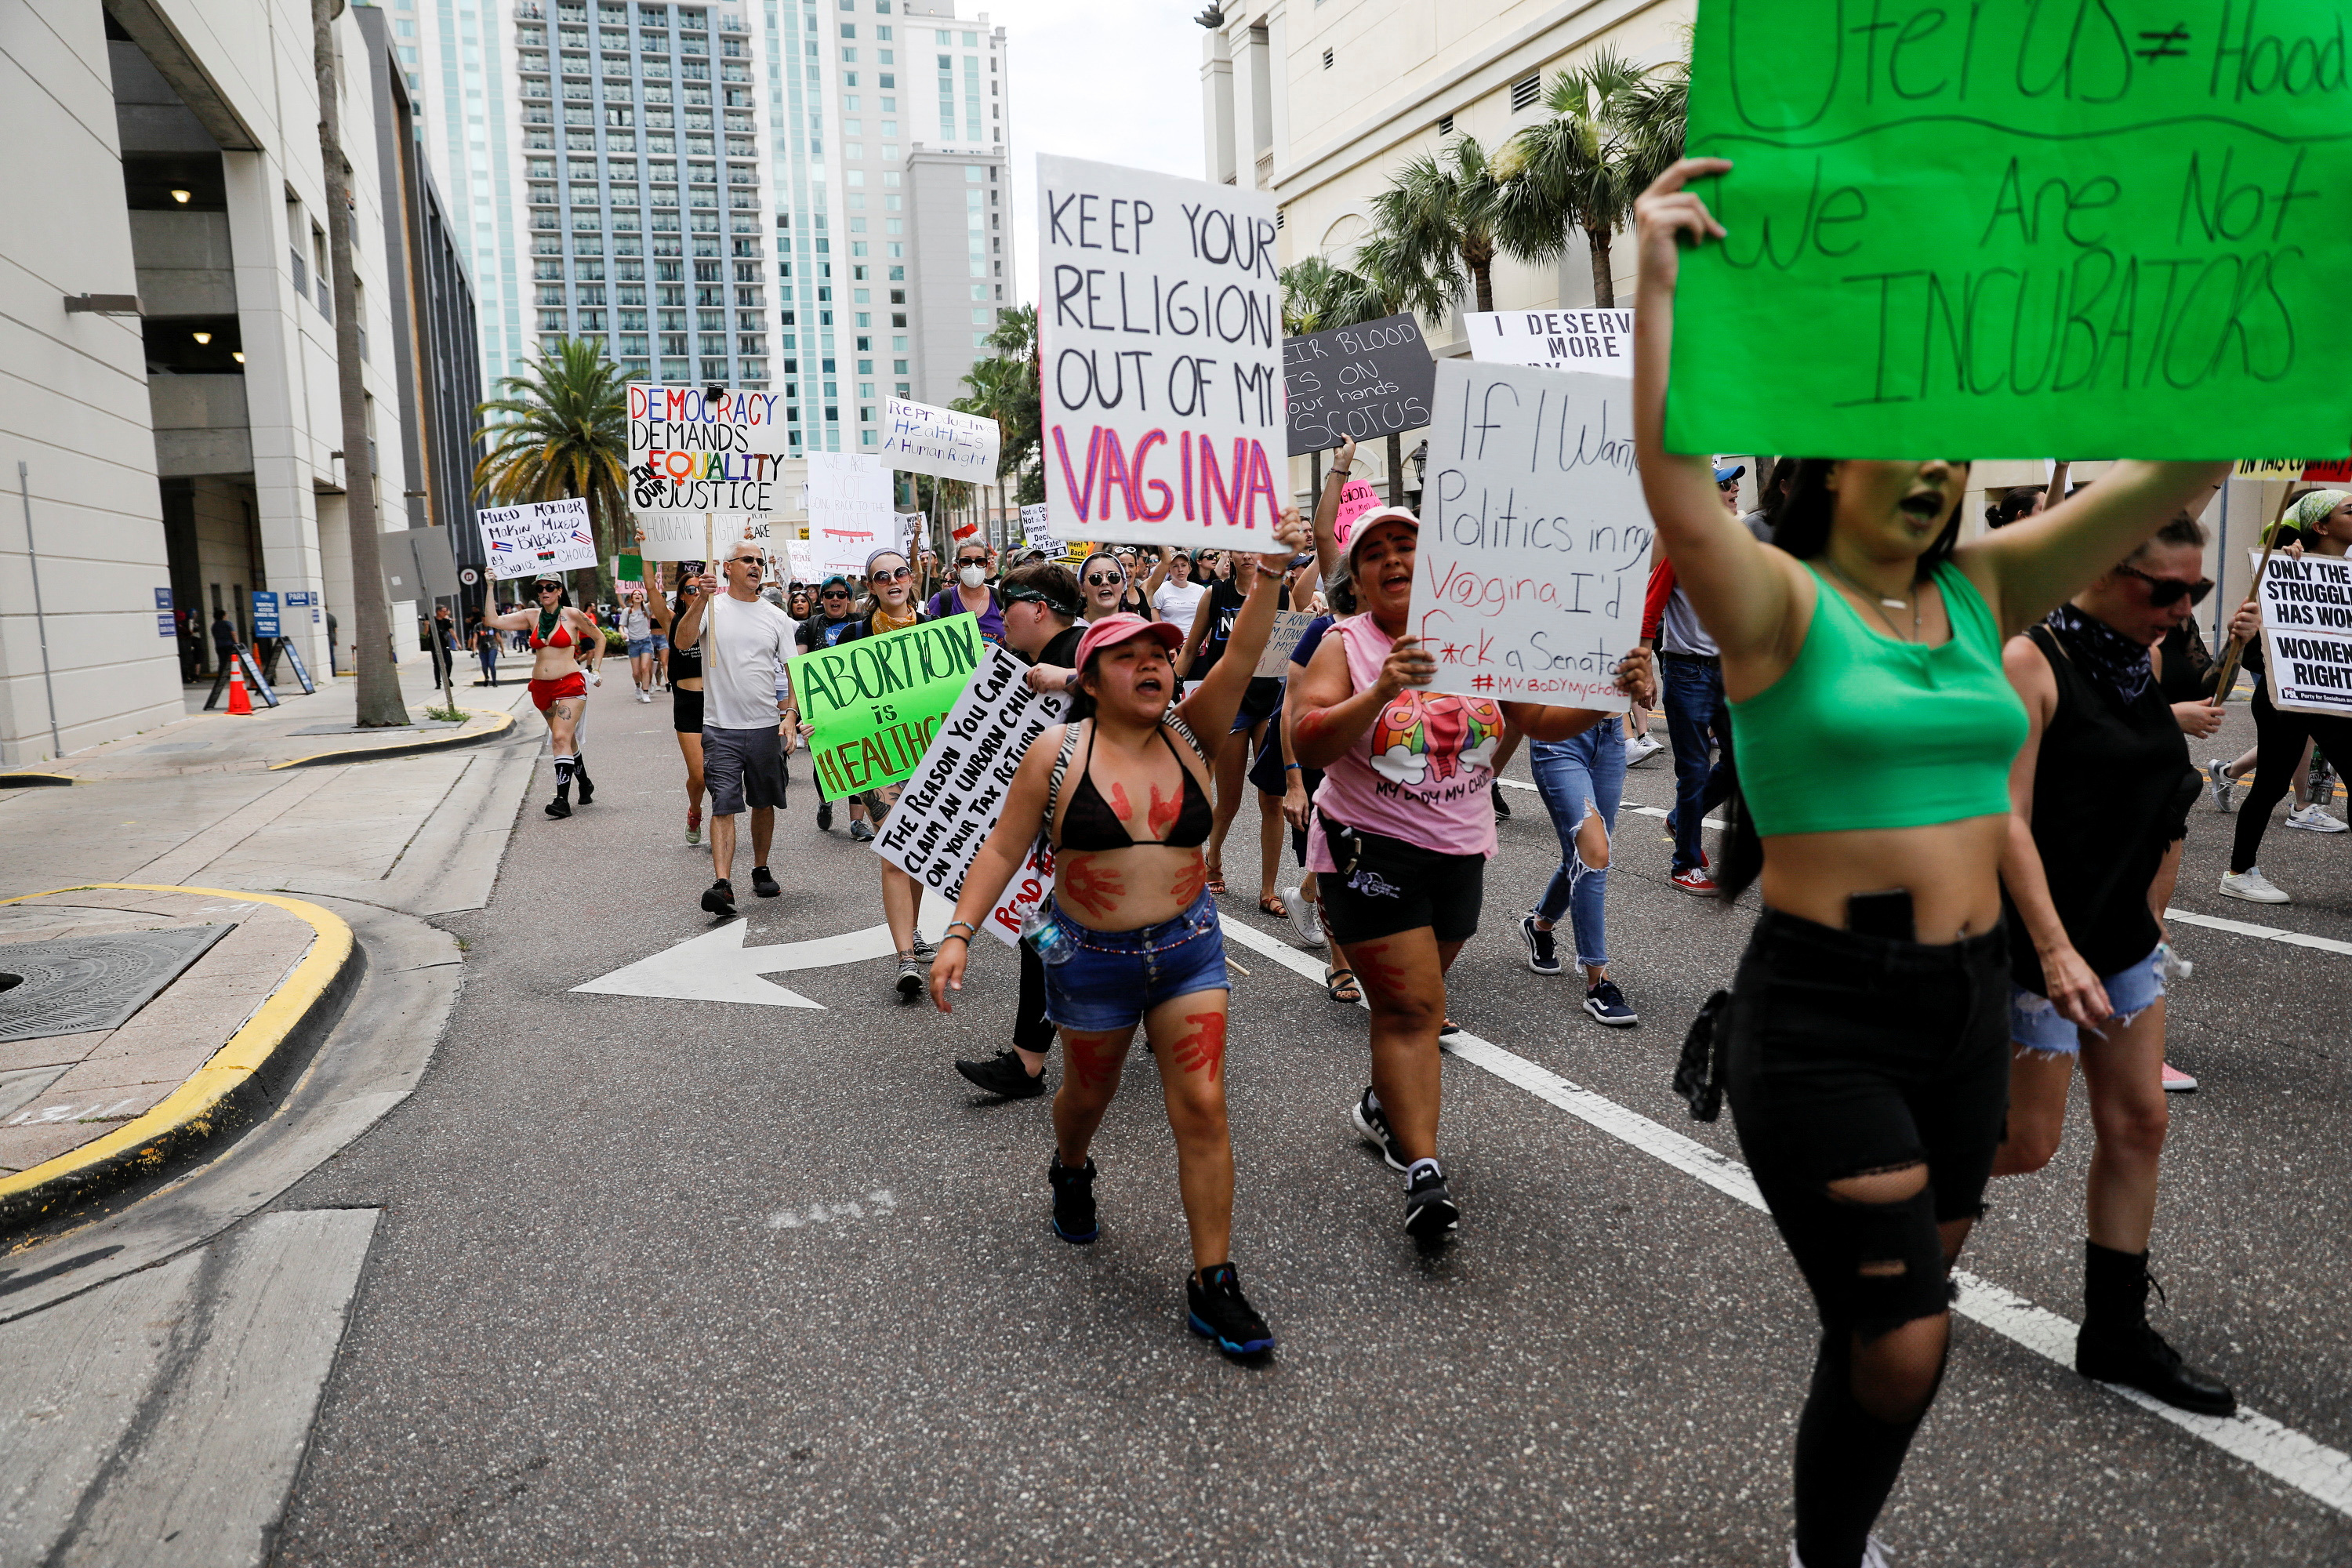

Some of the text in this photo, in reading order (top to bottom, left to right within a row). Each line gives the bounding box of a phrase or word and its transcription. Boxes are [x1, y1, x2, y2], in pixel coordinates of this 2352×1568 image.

[1047, 189, 1278, 281] KEEP YOUR
[1054, 264, 1272, 350] RELIGION
[1335, 324, 1416, 355] BLOOD
[1494, 315, 1504, 336] I
[1832, 247, 2306, 410] INCUBATORS
[1547, 336, 1621, 358] MORE
[1057, 348, 1275, 427] OUT OF MY
[1283, 359, 1378, 399] IS ON
[1336, 380, 1399, 403] hands
[630, 387, 779, 426] DEMOCRACY
[1294, 397, 1430, 448] SCOTUS
[632, 420, 749, 453] DEMANDS
[895, 419, 958, 443] Health
[1461, 379, 1519, 461] If
[1531, 389, 1546, 473] I
[822, 453, 869, 474] WE ARE
[884, 437, 989, 467] A Human Right
[629, 461, 657, 488] IN
[648, 450, 785, 487] EQUALITY
[1052, 424, 1281, 529] VAGINA
[633, 478, 774, 512] OUR JUSTICE
[832, 474, 866, 500] NOT
[809, 495, 886, 512] GOING BACK TO THE
[1436, 469, 1572, 552] Politics
[1589, 519, 1617, 554] in
[645, 514, 692, 543] HUMAN
[1025, 524, 1047, 534] Women
[1032, 539, 1062, 551] Our Fate!
[684, 564, 699, 573] NOT
[2267, 559, 2351, 585] ONLY THE
[1564, 572, 1621, 619] I'd
[1273, 612, 1287, 624] I
[2274, 603, 2314, 626] HAS
[803, 620, 978, 720] ABORTION
[2300, 692, 2315, 701] Party
[2323, 694, 2346, 703] Socialism
[881, 815, 920, 851] THE
[904, 746, 961, 817] REASON
[947, 704, 989, 742] YOU
[974, 648, 1017, 703] CANT
[904, 819, 948, 874] CLAIM
[938, 792, 962, 824] AN
[954, 724, 1007, 793] UNBORN
[925, 695, 1062, 887] ON YOUR TAX RETURN IS
[1375, 782, 1400, 798] MY
[1445, 782, 1465, 802] MY
[994, 878, 1043, 935] READ
